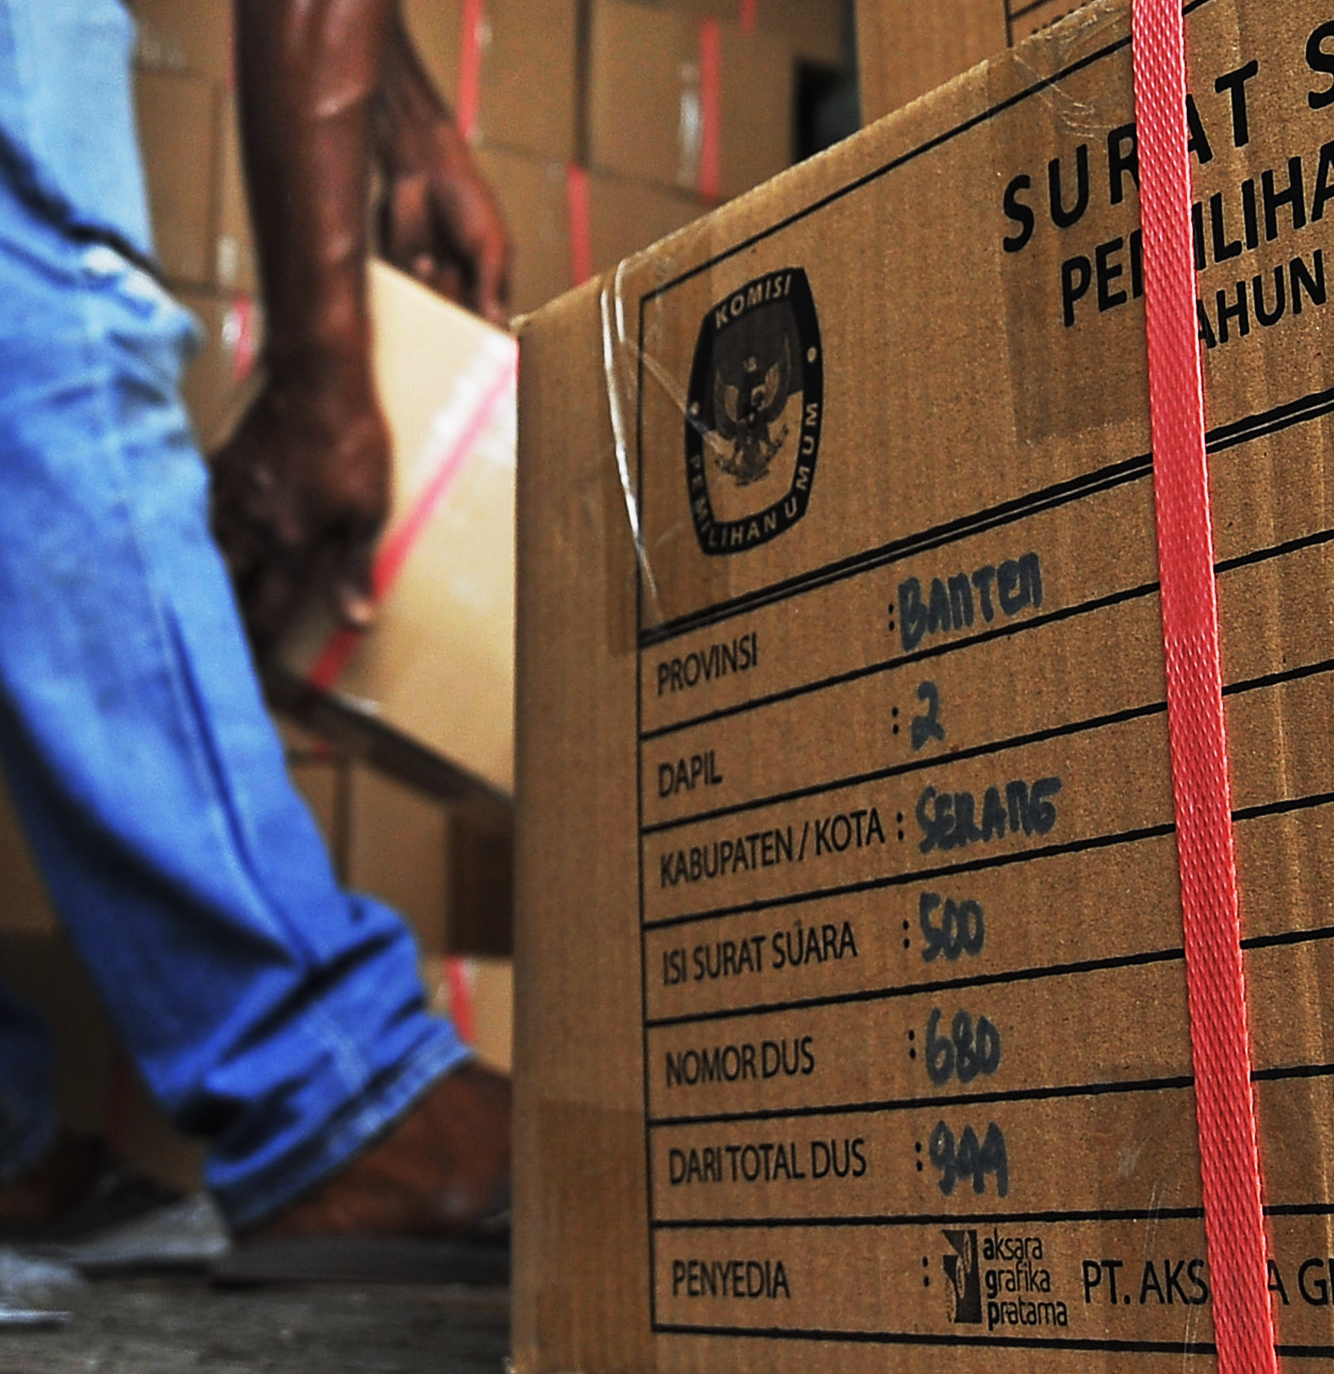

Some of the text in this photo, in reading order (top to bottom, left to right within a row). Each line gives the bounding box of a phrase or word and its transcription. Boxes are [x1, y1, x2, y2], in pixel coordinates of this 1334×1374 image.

[716, 274, 791, 329] KOMISI
[690, 403, 818, 547] PEMILIHAN UMUM
[898, 551, 1043, 652] BANTEN
[657, 632, 759, 696] PROVINSI
[911, 680, 945, 752] 2
[658, 750, 723, 798] DAPIL
[814, 807, 886, 854] KOTA
[919, 891, 986, 963] 500
[662, 950, 687, 986] ISI
[693, 935, 766, 983] SURAT
[773, 921, 857, 968] SUARA
[666, 1045, 756, 1088] NOMOR
[761, 1036, 815, 1077] DUS
[925, 1007, 1001, 1087] 680
[669, 1146, 721, 1185] DARI
[722, 1141, 805, 1182] TOTAL
[810, 1138, 866, 1178] DUS
[983, 1228, 1043, 1261] aksara
[672, 1259, 791, 1299] PENYEDIA
[985, 1260, 1051, 1299] grafika
[1082, 1258, 1131, 1306] PT.
[1139, 1258, 1290, 1306] AKSA
[988, 1300, 1067, 1331] pratama
